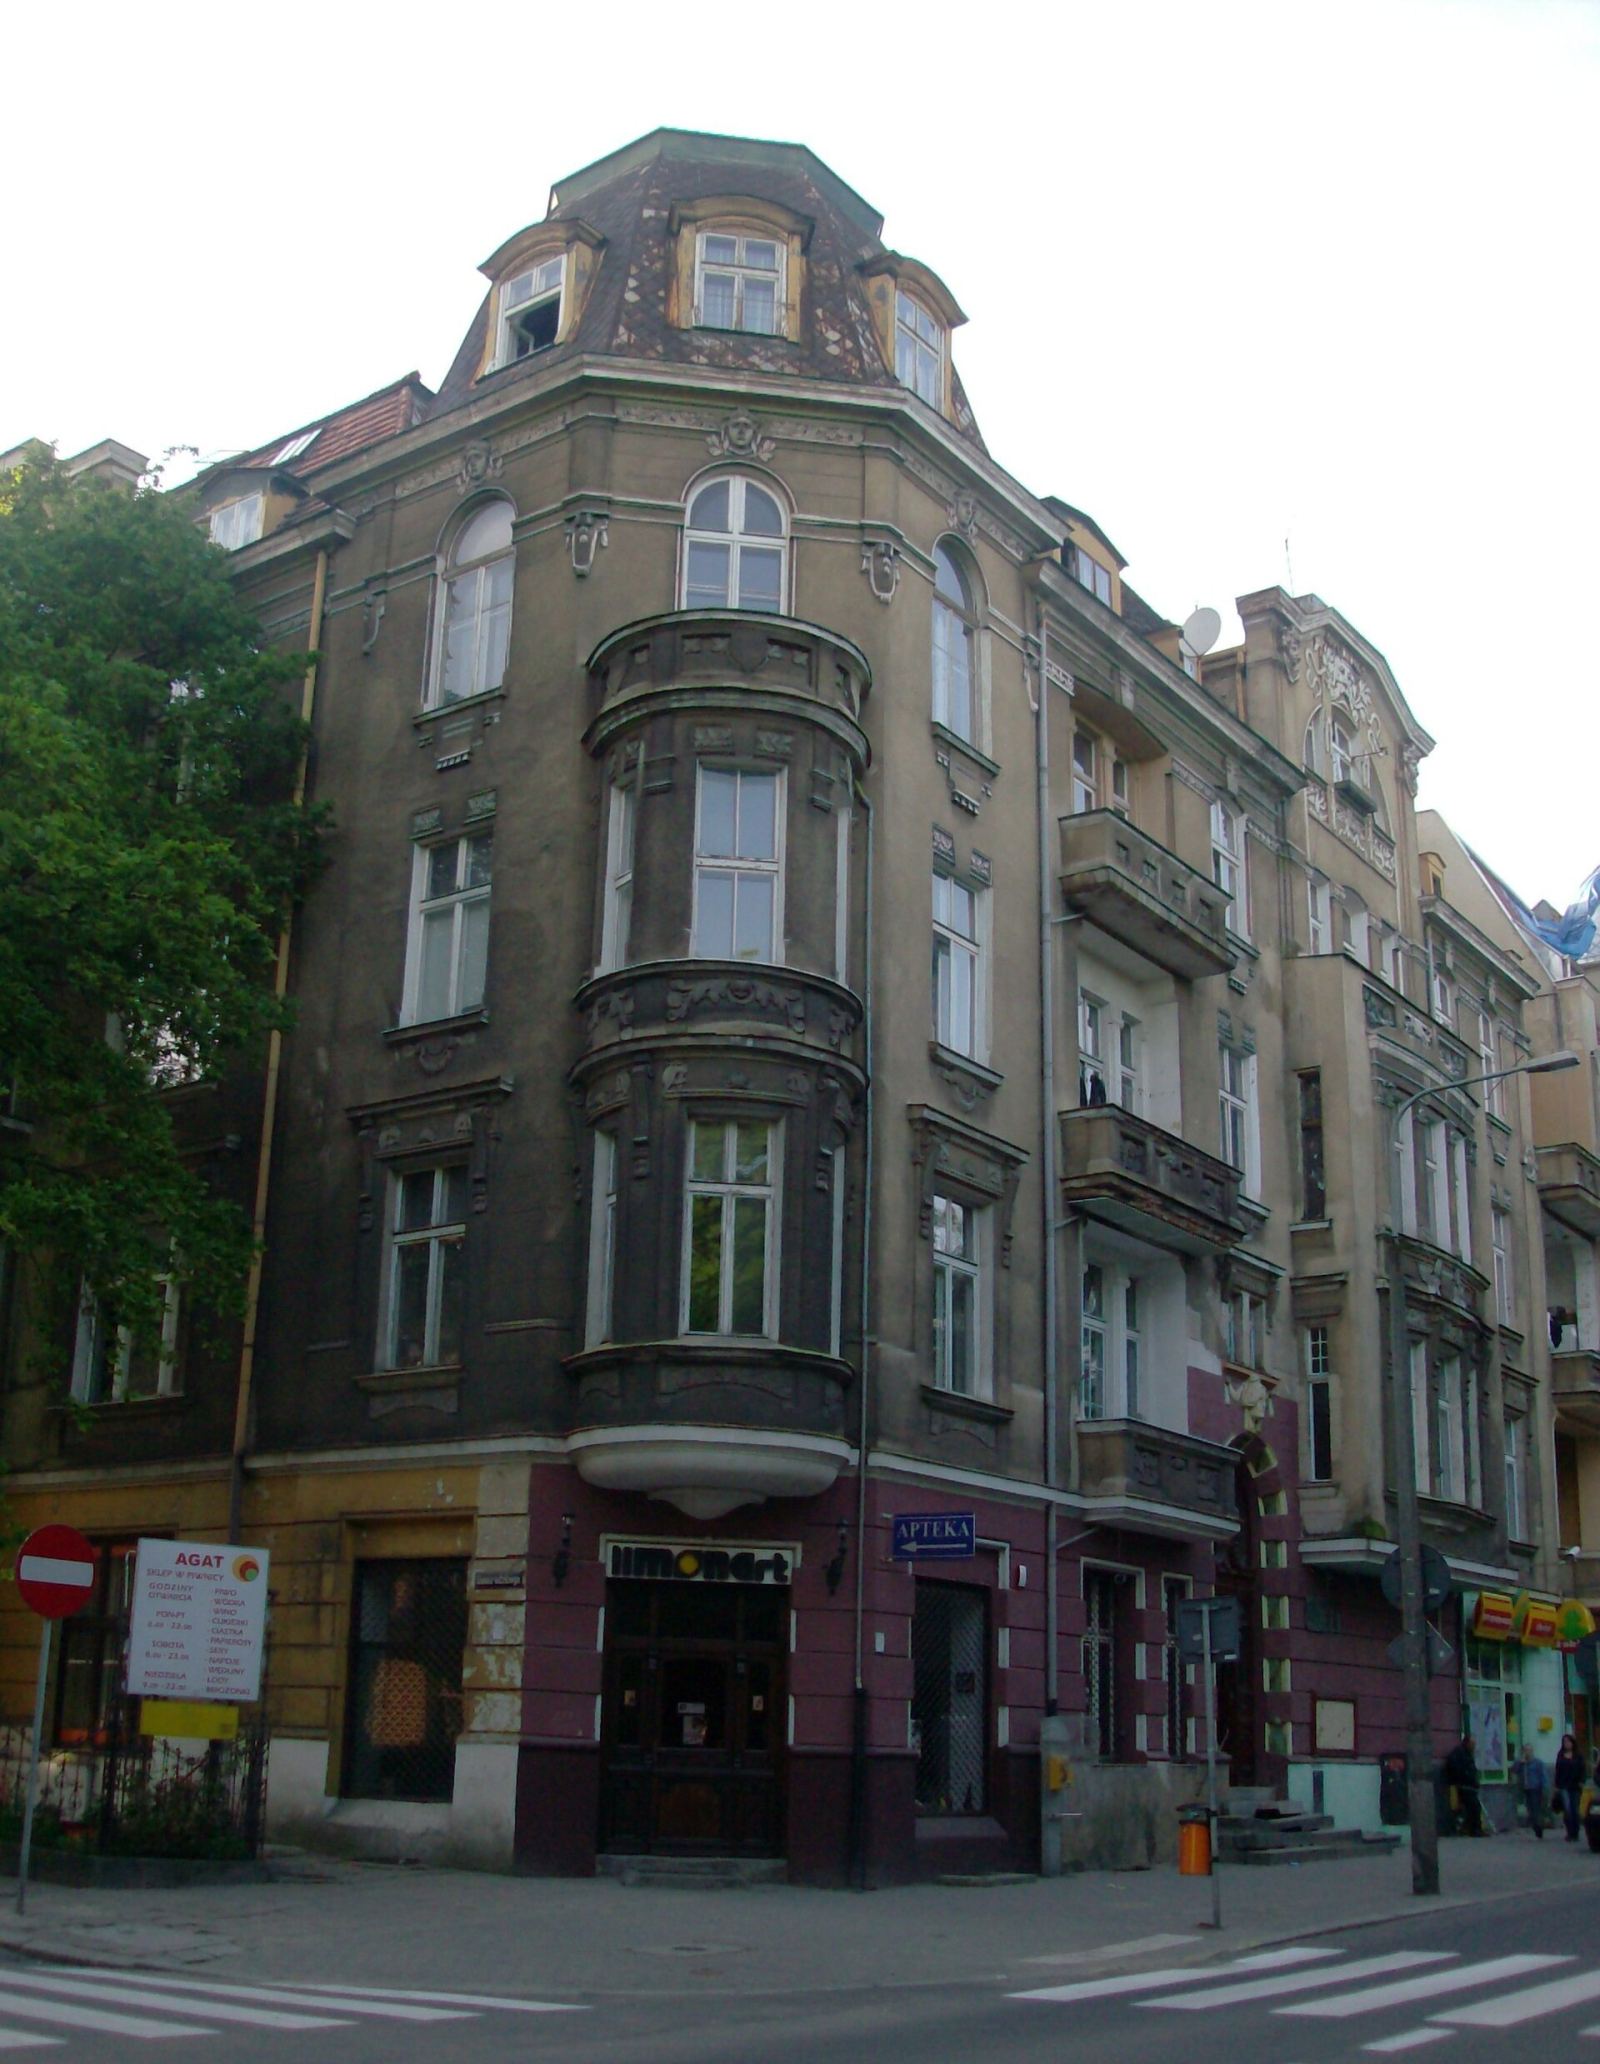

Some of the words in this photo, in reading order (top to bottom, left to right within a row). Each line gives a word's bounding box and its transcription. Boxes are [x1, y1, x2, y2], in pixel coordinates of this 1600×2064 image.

[896, 1520, 970, 1538] APTEKA
[175, 1553, 224, 1568] AGAT
[612, 1545, 788, 1583] limonart
[146, 1568, 173, 1577] SKLEP
[187, 1572, 225, 1581] PIWNICY
[149, 1582, 194, 1591] GODZINY
[148, 1592, 192, 1601] OTWARCIA
[213, 1608, 237, 1616] WINO
[211, 1617, 248, 1626] CUKIERKI
[211, 1627, 243, 1635] CIASTKA
[152, 1640, 185, 1649] SOBOTA
[210, 1637, 252, 1646] PAPIEROSY
[209, 1657, 239, 1665] NAPOJE
[144, 1671, 187, 1680] NIEDZIELA
